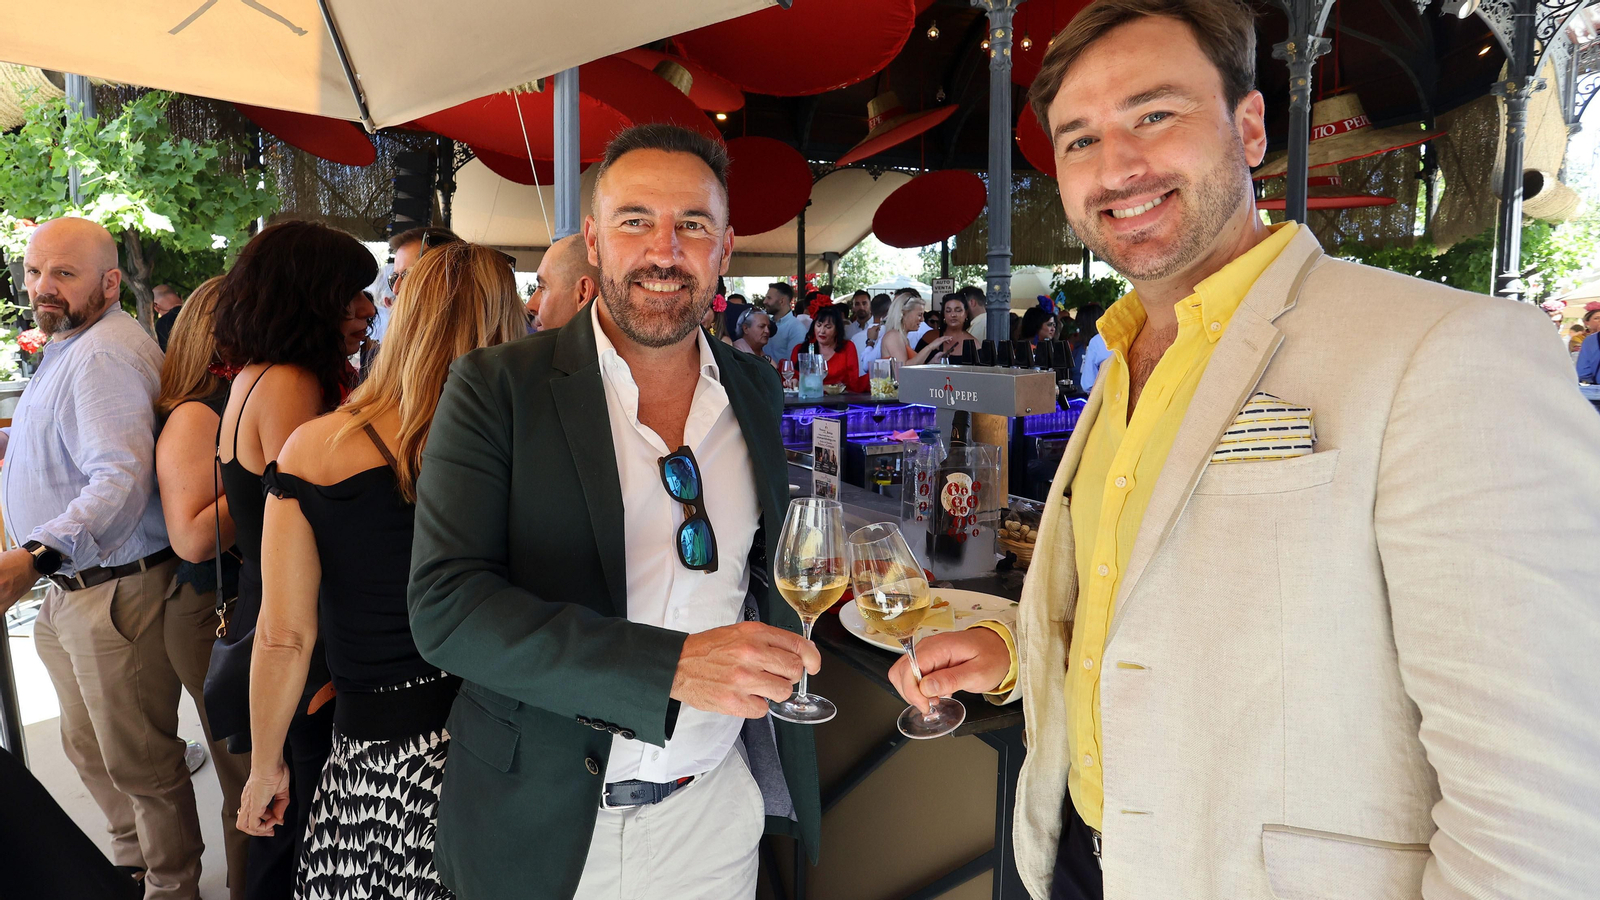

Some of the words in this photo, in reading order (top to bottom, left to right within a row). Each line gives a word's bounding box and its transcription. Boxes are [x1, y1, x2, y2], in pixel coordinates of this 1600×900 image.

[1313, 124, 1336, 139] TIO
[929, 388, 944, 399] TIO
[955, 390, 979, 402] PEPE
